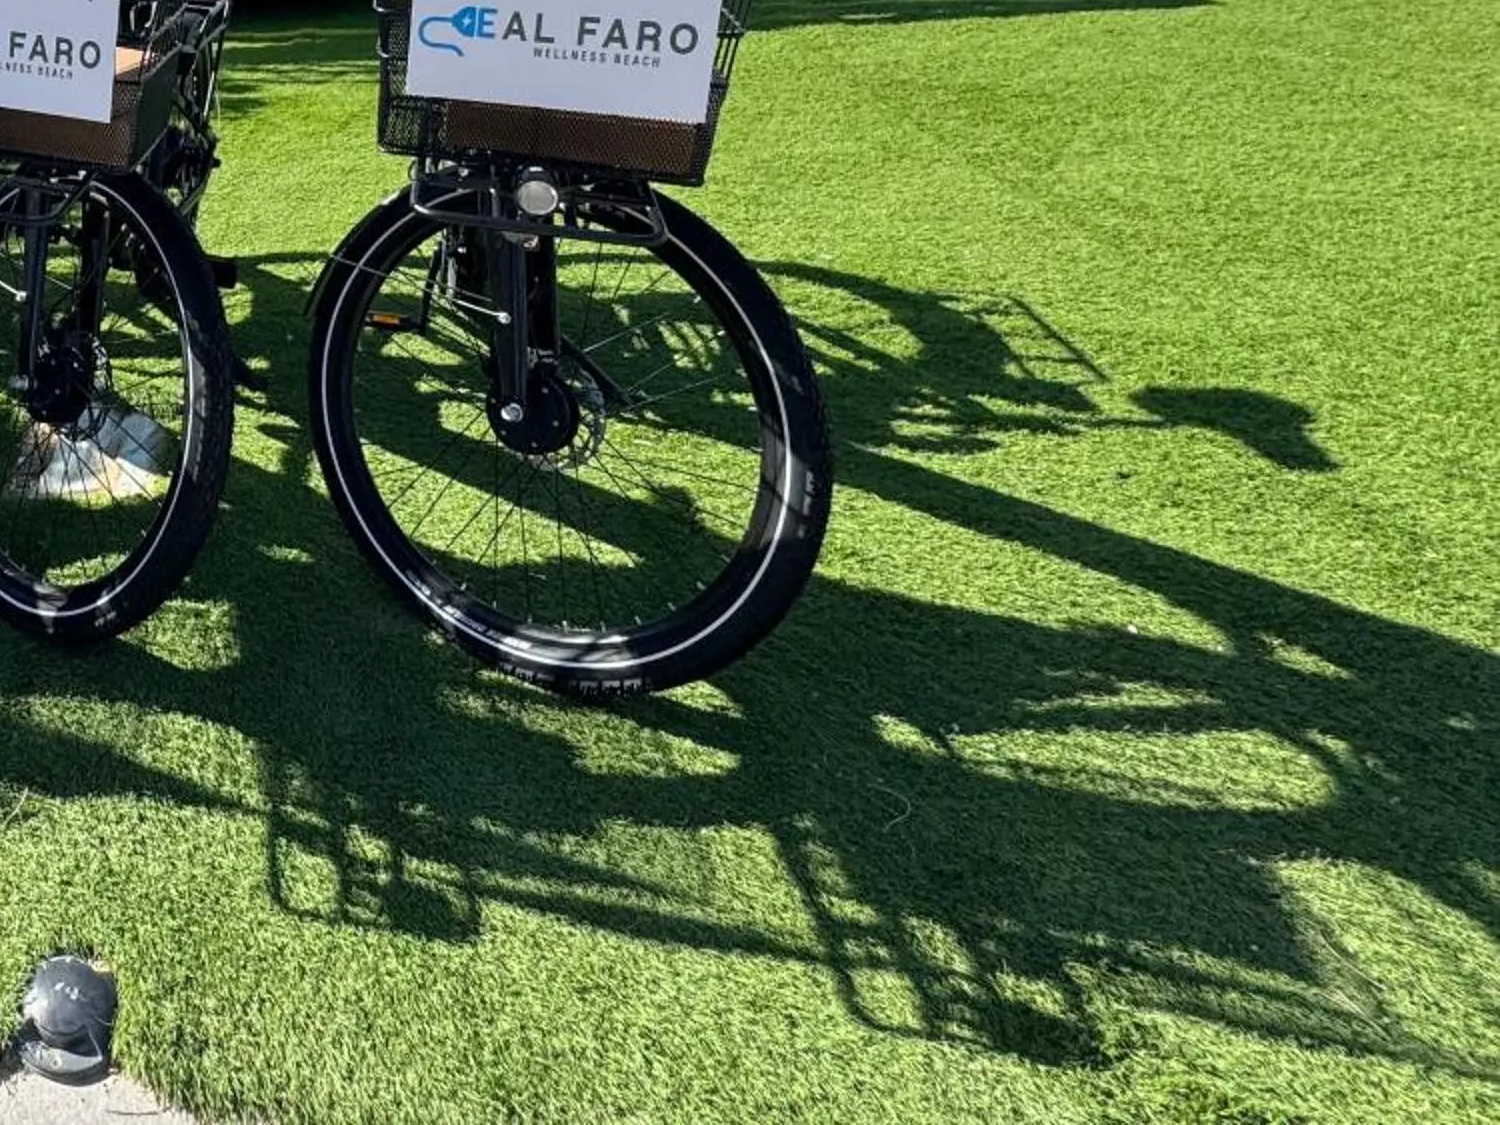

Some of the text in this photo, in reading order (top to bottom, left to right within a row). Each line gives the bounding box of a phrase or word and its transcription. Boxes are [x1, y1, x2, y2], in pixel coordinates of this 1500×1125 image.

[9, 31, 100, 69] FARO
[577, 16, 698, 54] FARO
[533, 47, 661, 68] WELLNESS BEACH
